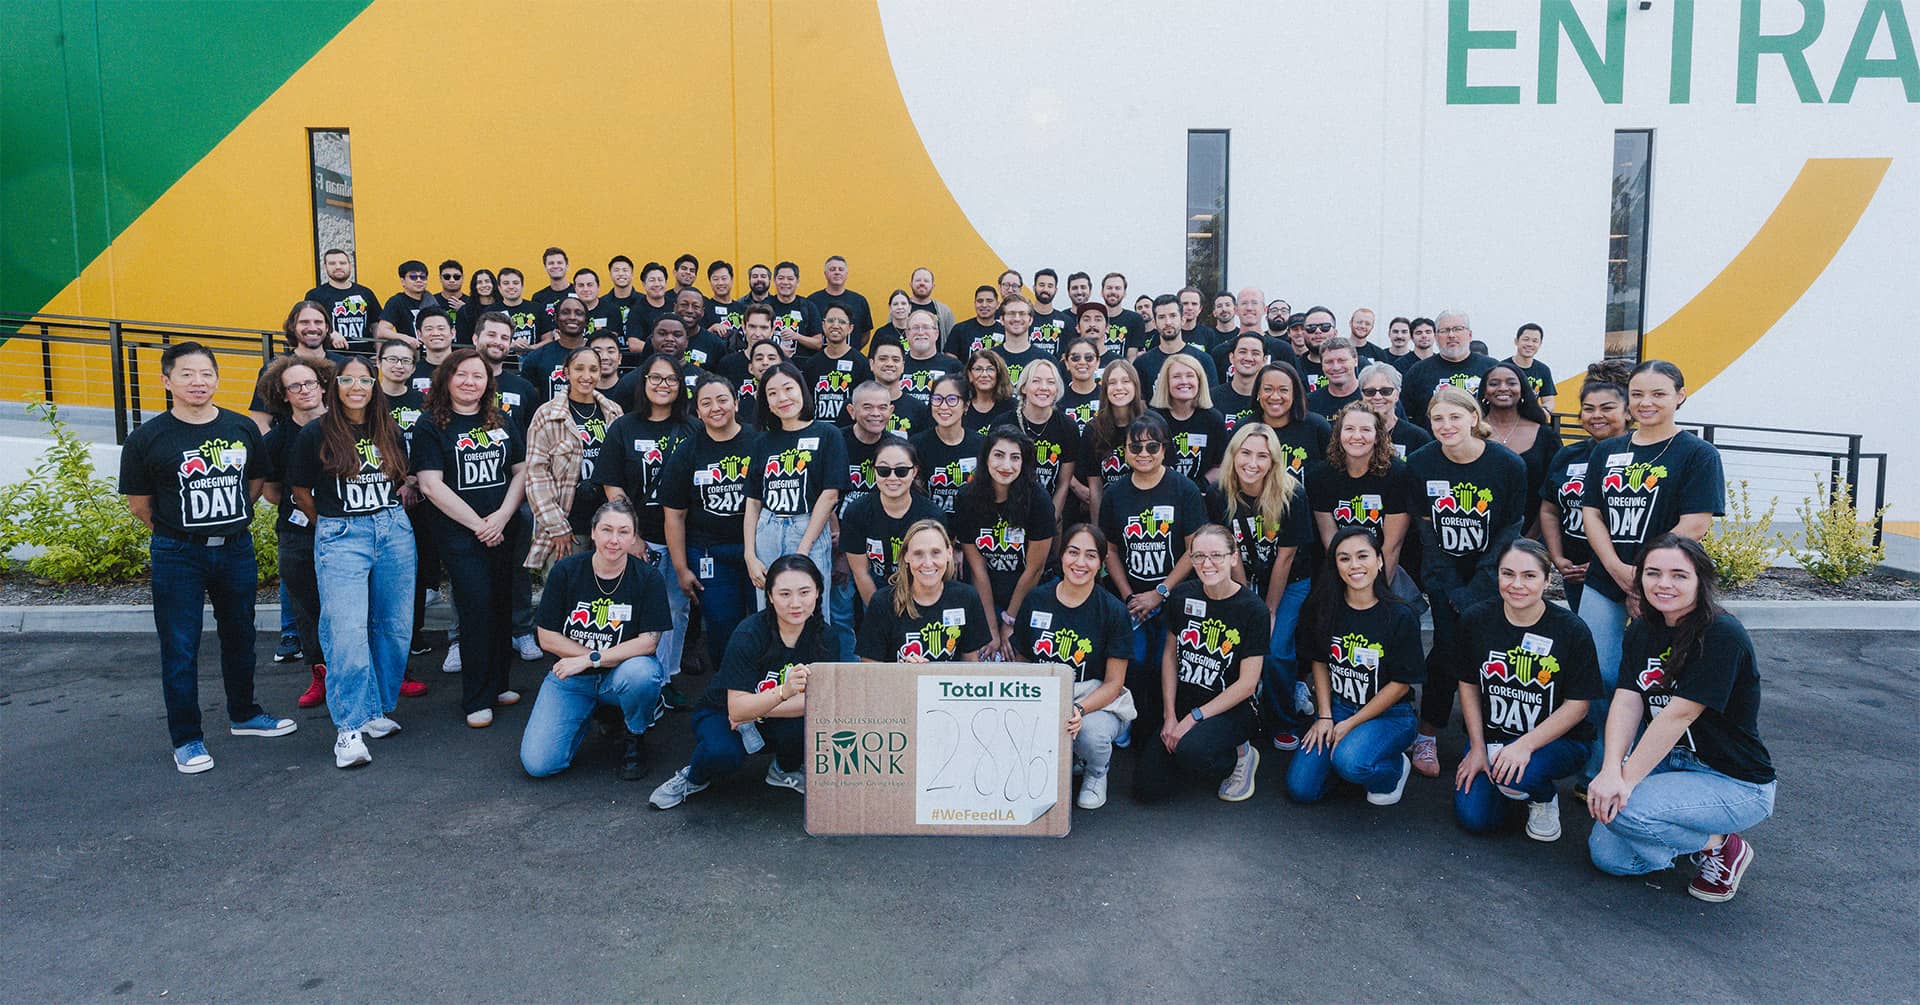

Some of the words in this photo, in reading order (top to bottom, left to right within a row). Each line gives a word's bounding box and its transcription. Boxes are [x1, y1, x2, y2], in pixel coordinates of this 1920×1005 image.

[338, 323, 364, 338] DAY
[819, 401, 843, 418] DAY
[464, 450, 500, 461] COREGIVING
[465, 459, 500, 484] DAY
[189, 475, 239, 489] COREGIVING
[768, 479, 799, 489] COREGIVING
[190, 485, 237, 519] DAY
[346, 482, 391, 508] DAY
[708, 491, 744, 511] DAY
[767, 488, 800, 511] DAY
[1441, 516, 1481, 528] COREGIVING
[1609, 507, 1645, 536] DAY
[1130, 541, 1166, 551] COREGIVING
[1441, 526, 1483, 551] DAY
[1131, 550, 1166, 575] DAY
[570, 629, 613, 642] COREGIVING
[1182, 650, 1221, 671] COREGIVING
[1180, 659, 1219, 686] DAY
[938, 681, 993, 698] Total
[999, 681, 1042, 698] Kits
[1332, 671, 1369, 704] DAY
[1489, 685, 1542, 704] COREGIVING
[1490, 695, 1542, 732] DAY
[931, 808, 1015, 821] #WeFeedLA
